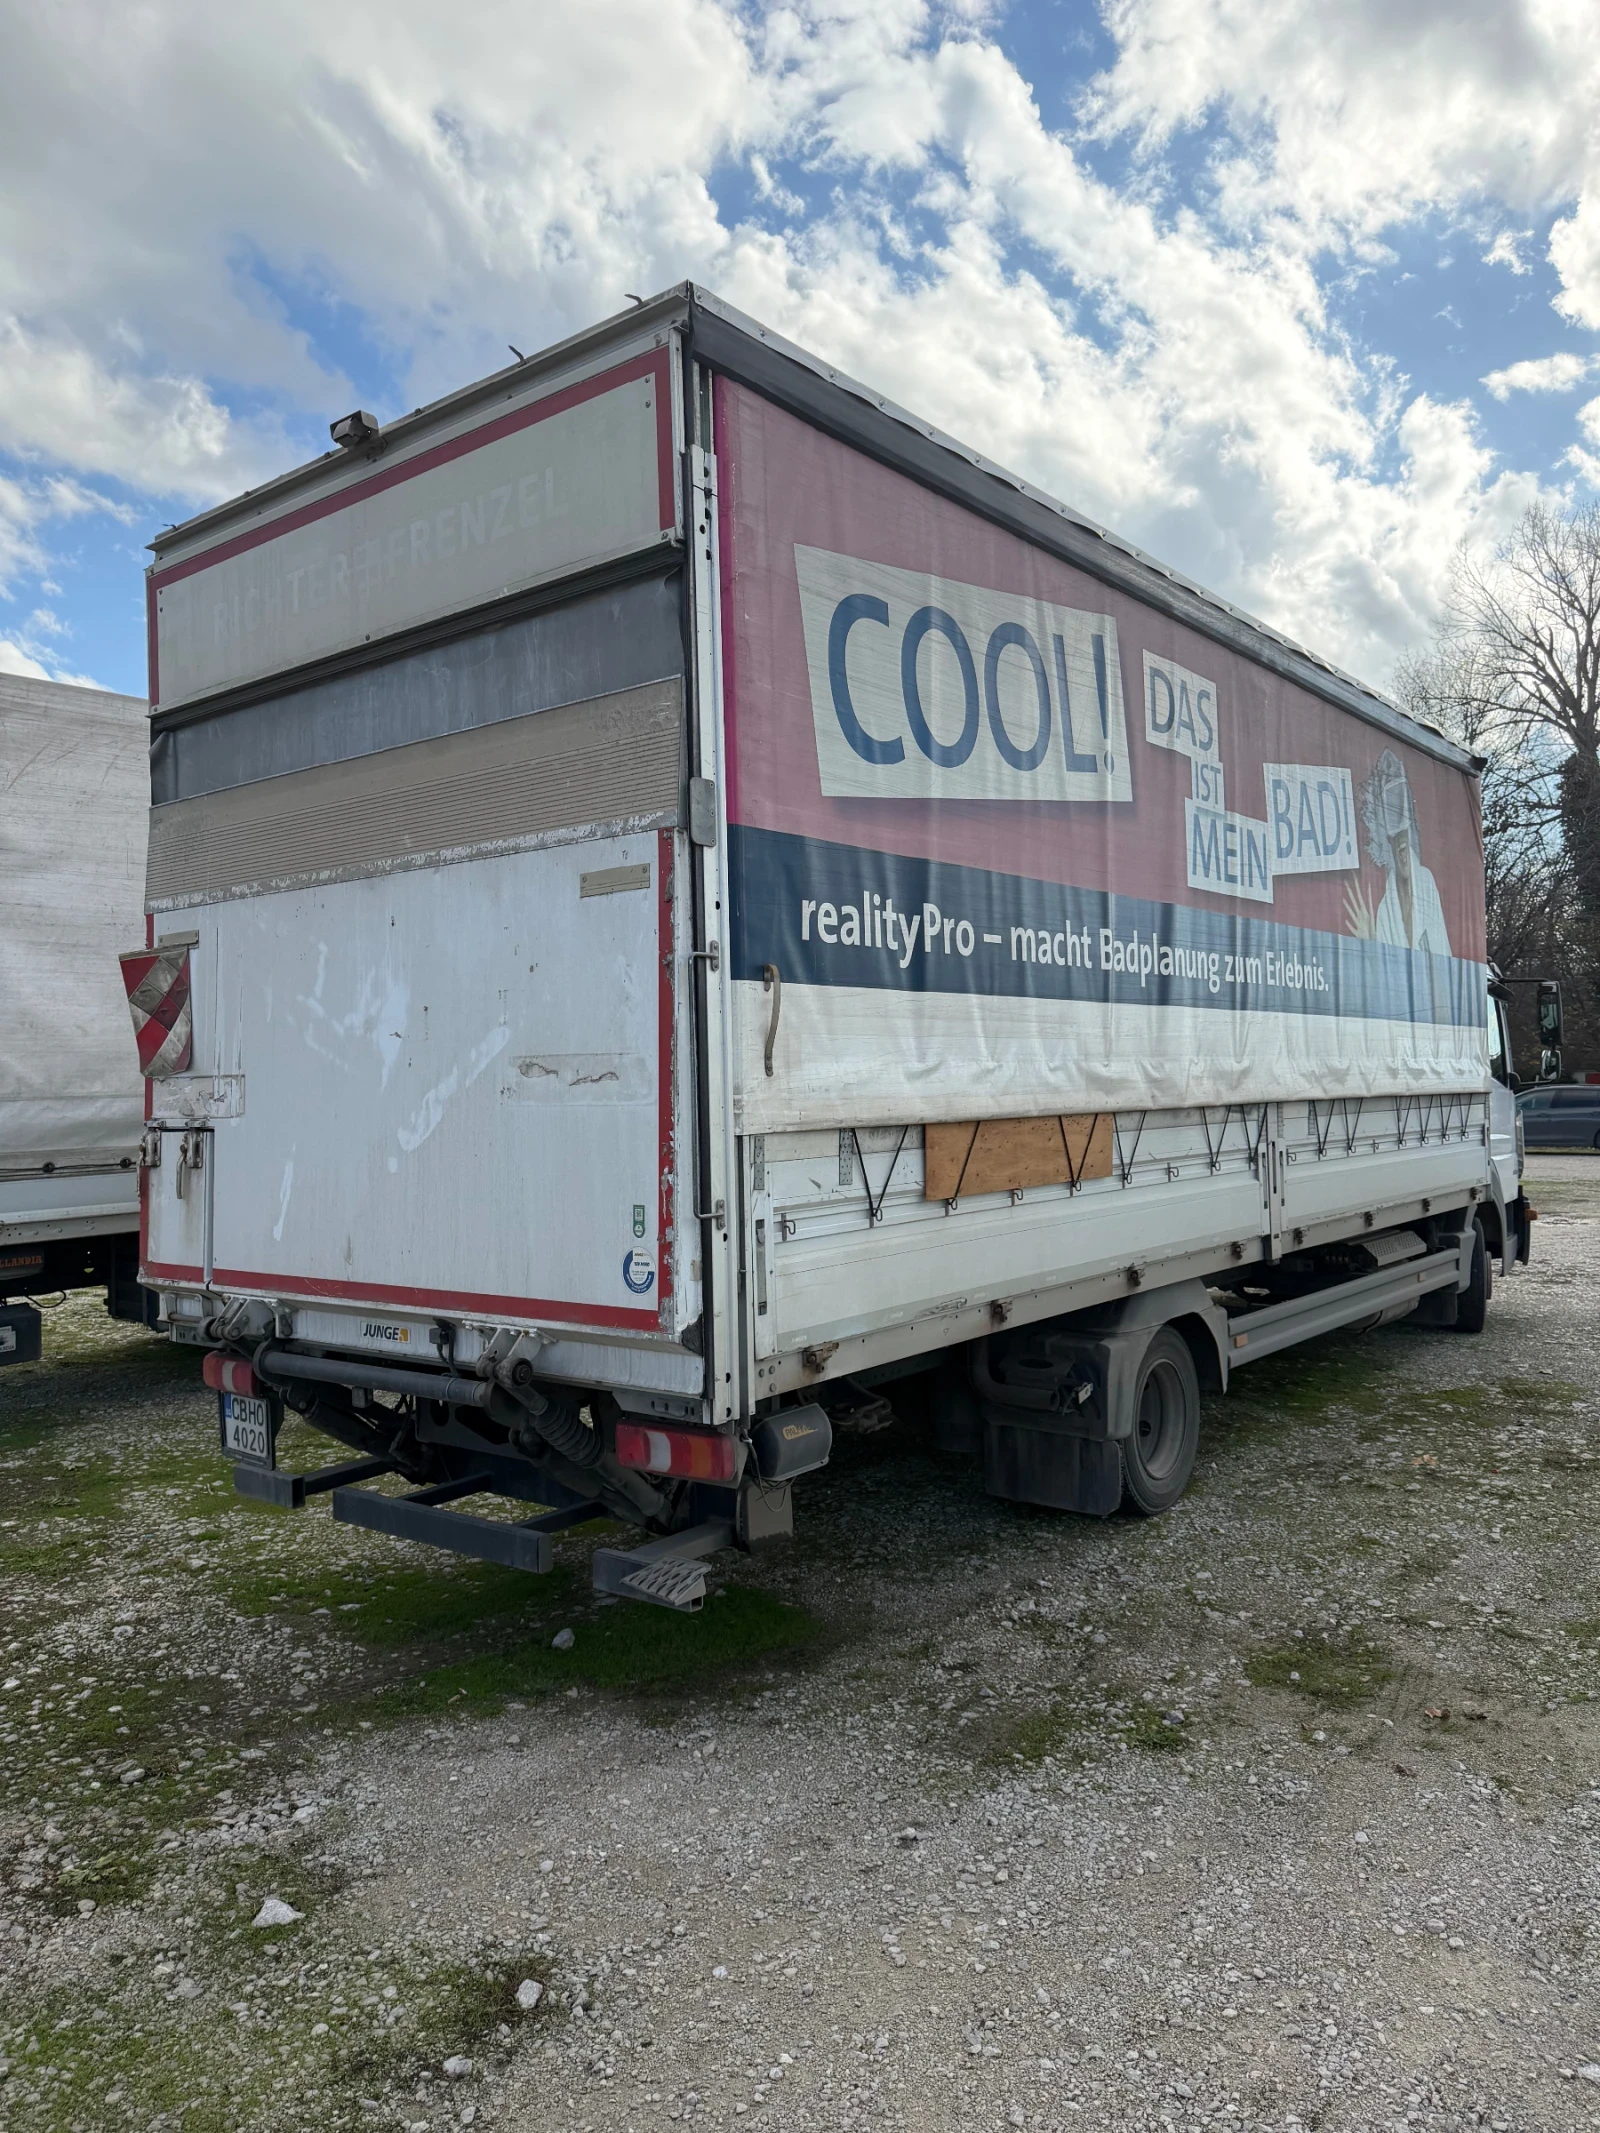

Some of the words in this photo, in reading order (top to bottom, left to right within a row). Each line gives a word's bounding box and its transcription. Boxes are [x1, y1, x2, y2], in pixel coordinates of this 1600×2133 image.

[828, 593, 1115, 775] COOL!
[1150, 667, 1213, 751] DAS
[1195, 761, 1221, 805] IST
[1272, 778, 1352, 859] BAD!
[1192, 813, 1268, 890] MEIN
[802, 890, 975, 968] realityPro
[1010, 920, 1093, 969] macht
[1099, 928, 1220, 993] Badplanung
[1225, 955, 1262, 985] zum
[1266, 951, 1329, 991] Erlebnis.
[363, 1323, 400, 1341] JUNGE
[232, 1397, 264, 1427] CBHO
[233, 1424, 265, 1454] 4020
